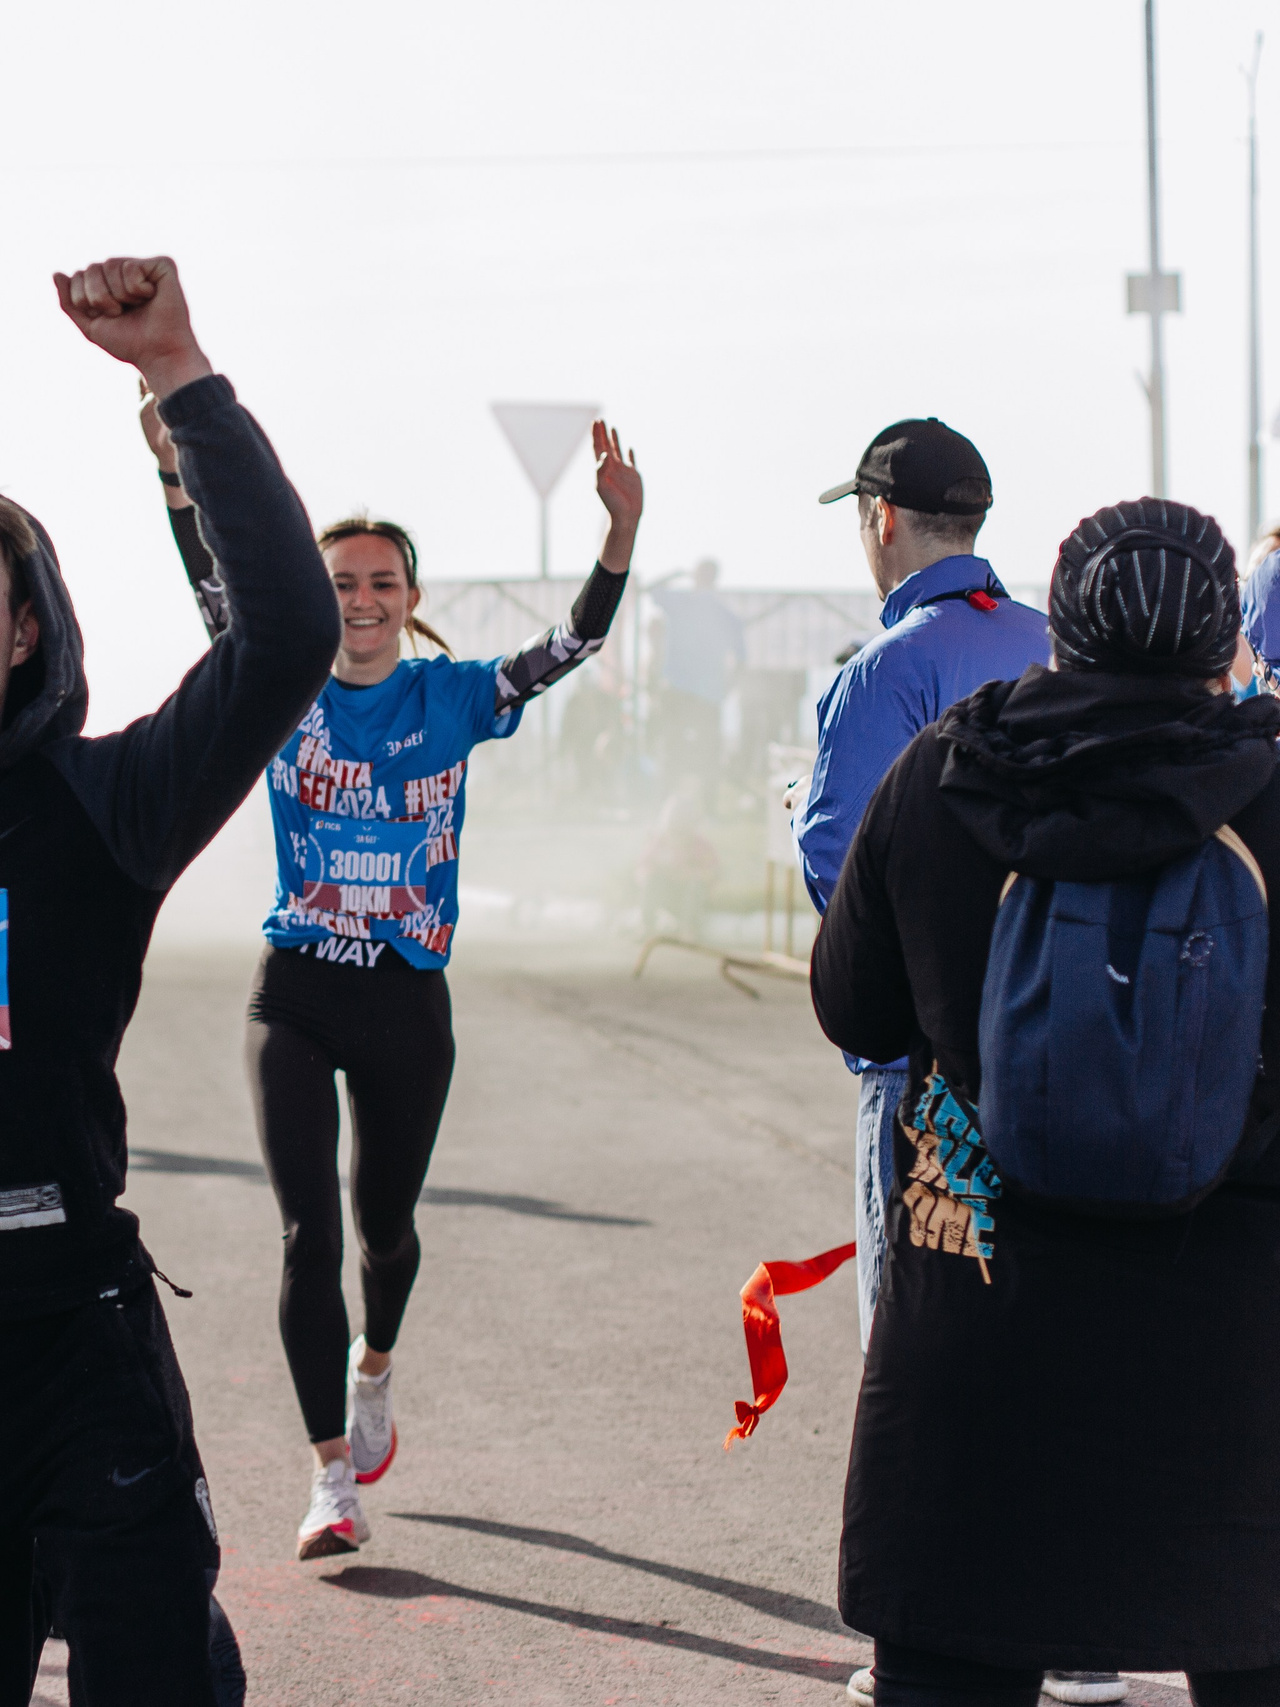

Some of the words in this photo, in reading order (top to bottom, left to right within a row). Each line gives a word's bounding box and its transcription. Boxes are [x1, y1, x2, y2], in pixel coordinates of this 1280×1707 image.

[329, 849, 401, 882] 30001
[339, 884, 391, 913] 10KM
[300, 936, 386, 968] WAY
